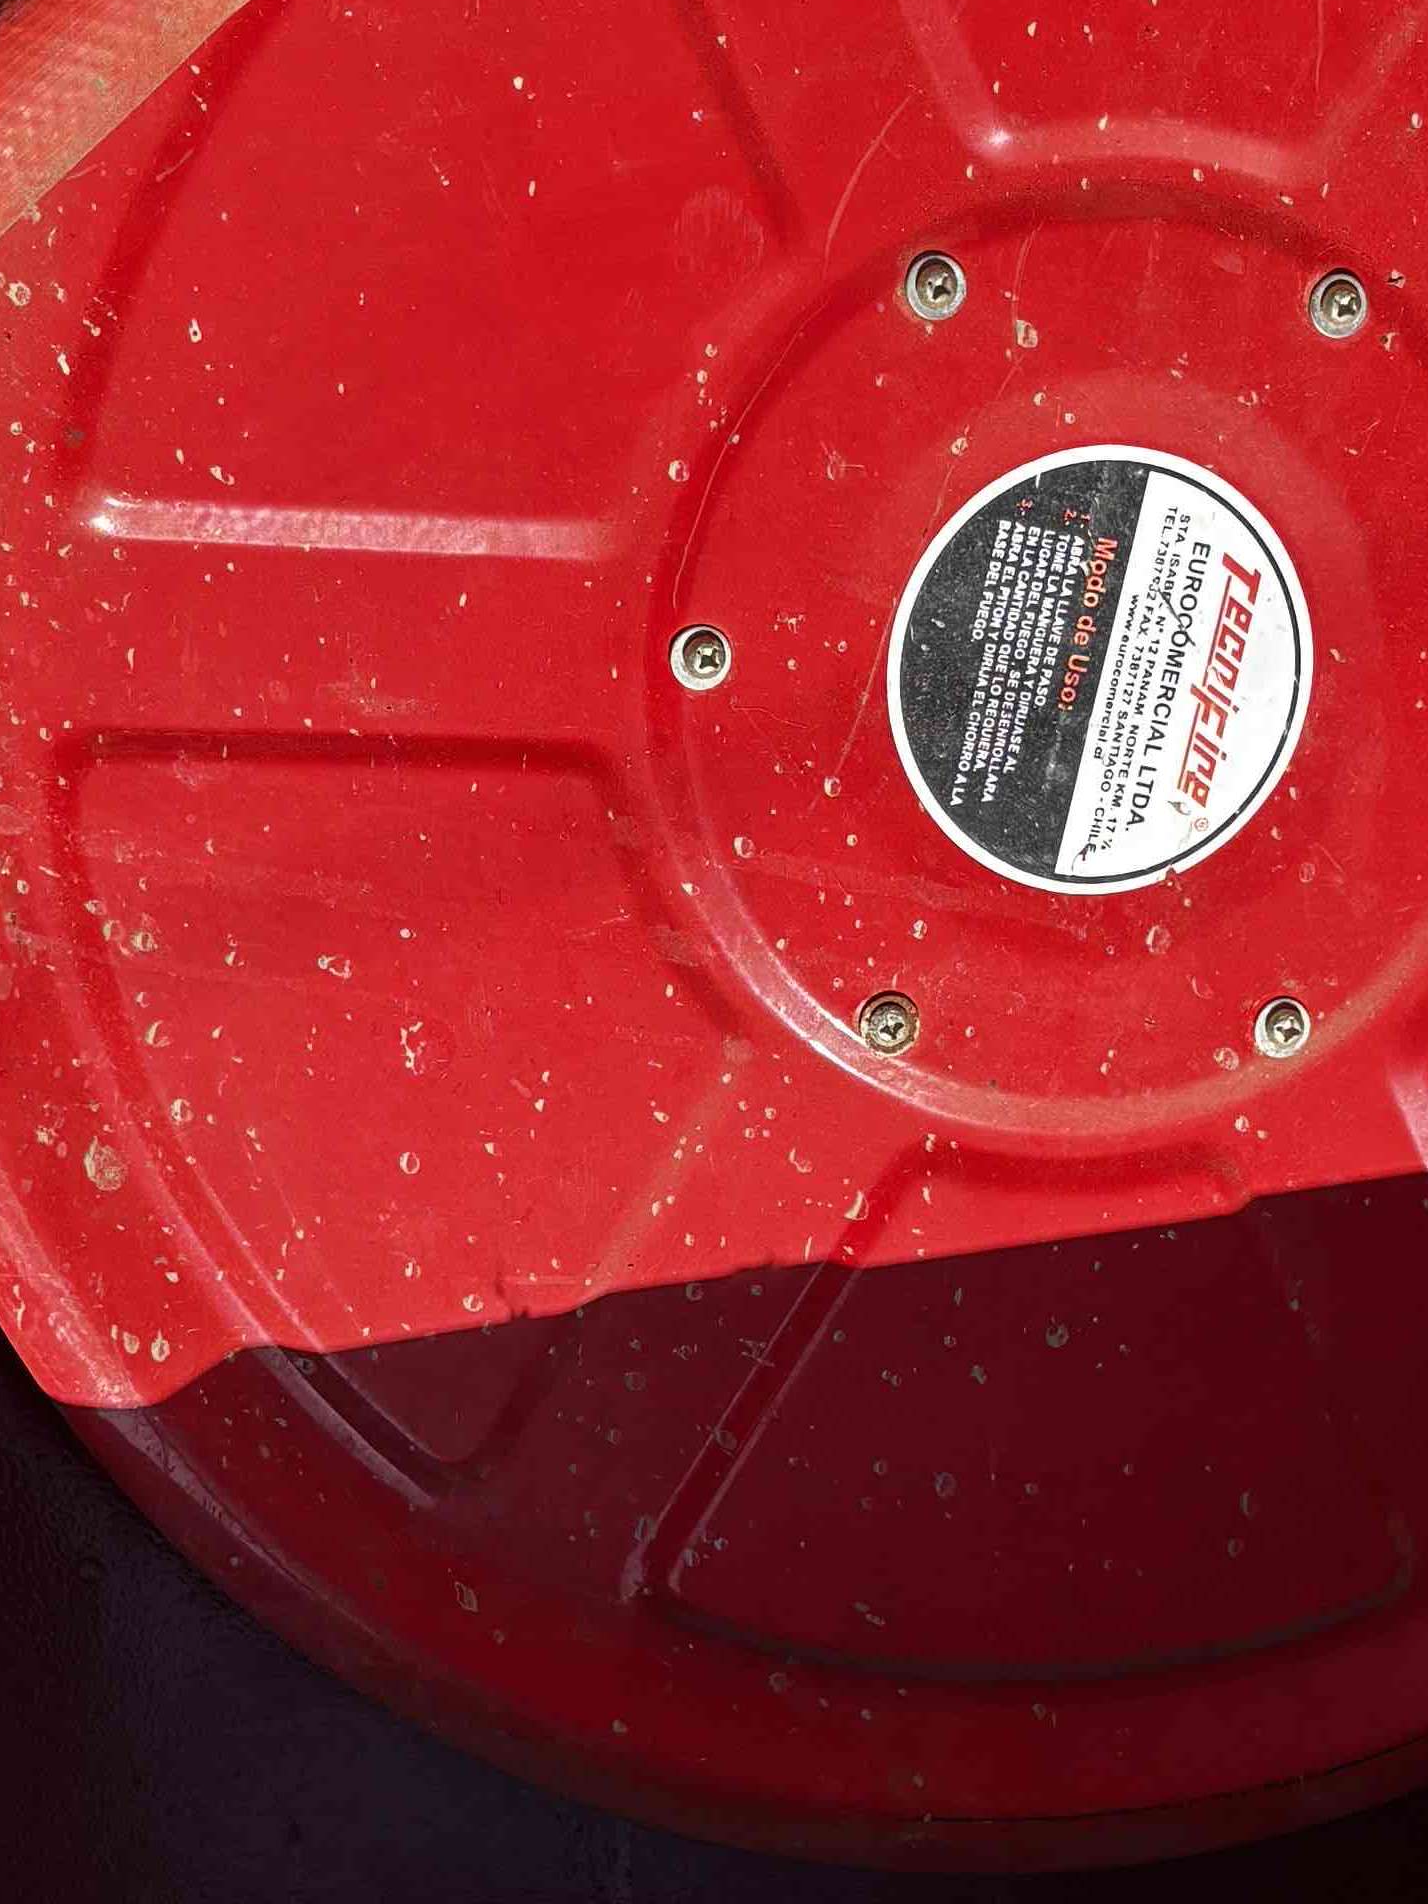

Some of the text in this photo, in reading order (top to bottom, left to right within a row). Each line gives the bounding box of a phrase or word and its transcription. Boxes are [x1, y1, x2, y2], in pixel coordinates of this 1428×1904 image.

[1005, 521, 1026, 564] ABRA
[1032, 528, 1056, 579] LUGAR
[1049, 532, 1070, 573] TOME
[1063, 535, 1086, 577] ABRA
[969, 518, 1012, 644] BASE DEL FUEGO.
[1000, 564, 1016, 585] EL
[1024, 580, 1043, 610] DEL
[1044, 573, 1060, 595] LA
[1058, 577, 1075, 598] LA
[989, 585, 1011, 629] PITON
[1047, 598, 1070, 645] LLAVE
[1056, 535, 1119, 712] Modo de Uso:
[970, 525, 1041, 774] EN LA CANTIDAD QUE LO REQUIERA.
[986, 630, 999, 641] Y
[1012, 610, 1036, 661] FUEGO
[1023, 595, 1055, 676] MANGUERA
[1042, 645, 1058, 666] DE
[1147, 637, 1161, 655] 12
[1006, 668, 1021, 689] SE
[1022, 678, 1034, 689] Y
[1031, 667, 1053, 711] PASO.
[1119, 644, 1144, 705] 7387127
[1124, 541, 1211, 834] EUROCOMERCIAL LTDA.
[970, 689, 986, 708] EL
[955, 710, 983, 772] CHORRO
[1098, 709, 1129, 793] SANTIAGO
[1116, 723, 1140, 779] NORTE
[953, 773, 968, 786] A
[1001, 754, 1018, 775] AL
[948, 786, 965, 808] LA
[1084, 806, 1106, 853] CHILE
[1104, 816, 1118, 833] 17
